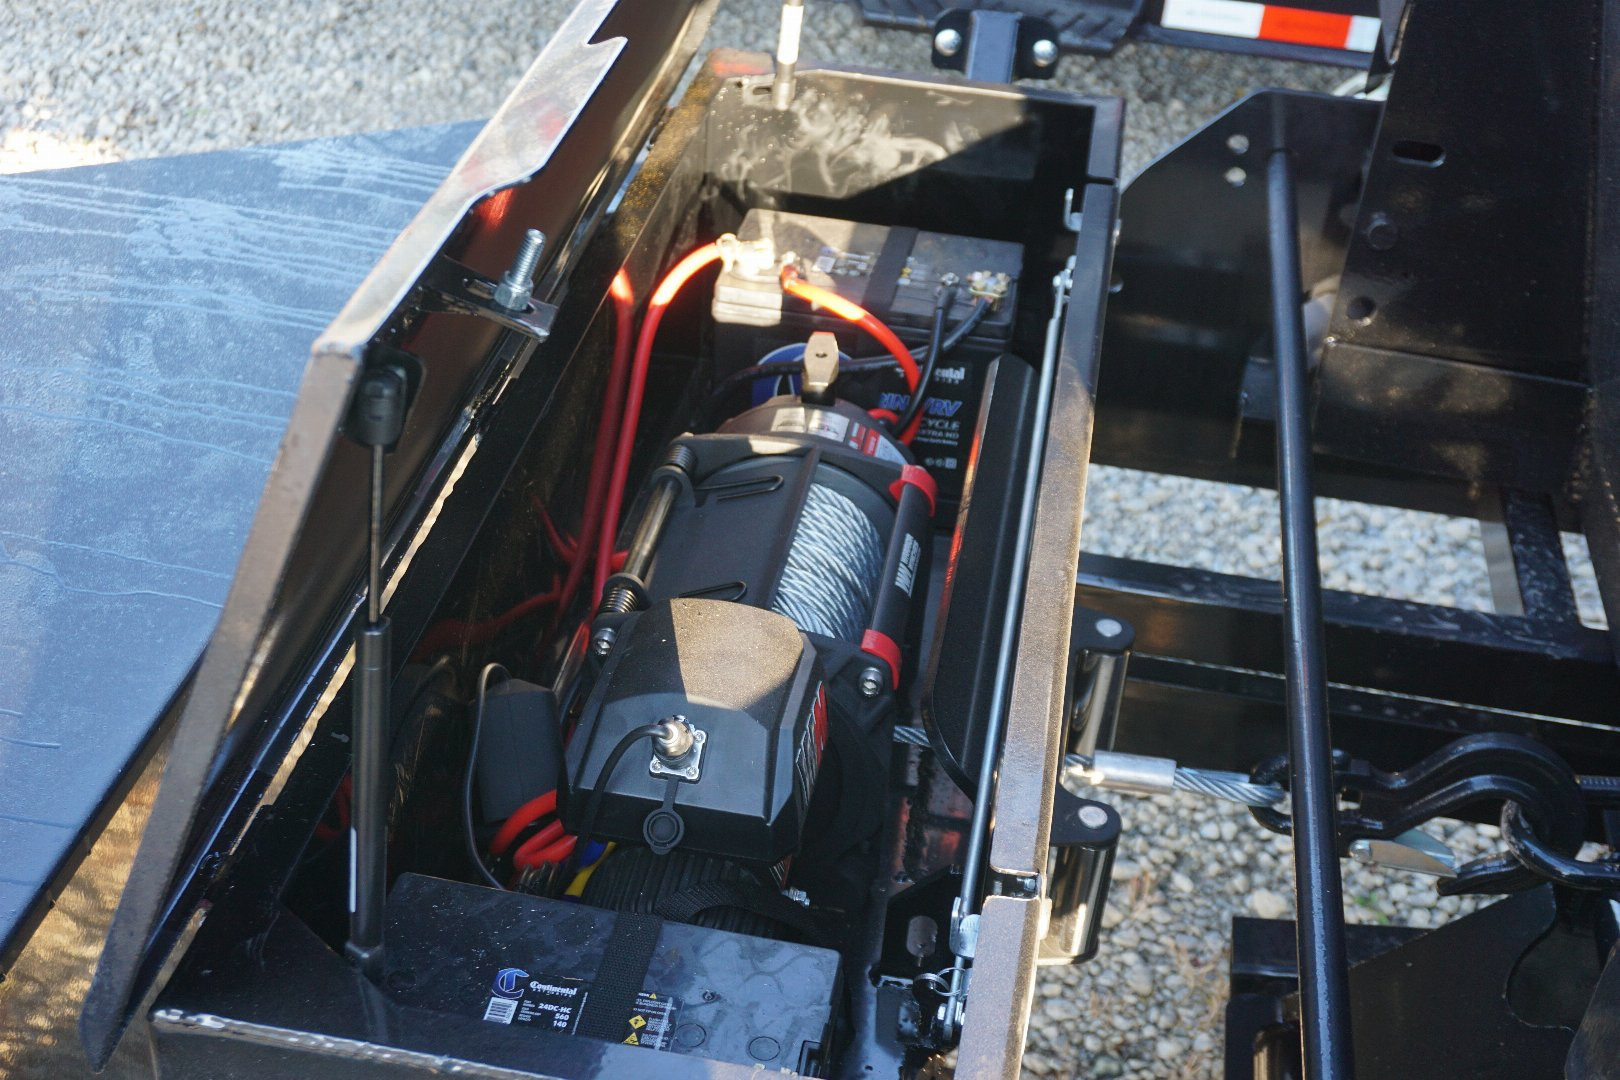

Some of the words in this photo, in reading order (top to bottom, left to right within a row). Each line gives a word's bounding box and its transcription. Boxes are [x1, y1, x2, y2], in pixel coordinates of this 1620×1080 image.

[529, 980, 578, 996] Continental
[538, 1002, 573, 1014] 24DC-HC
[554, 1013, 570, 1021] 560
[553, 1020, 568, 1028] 140
